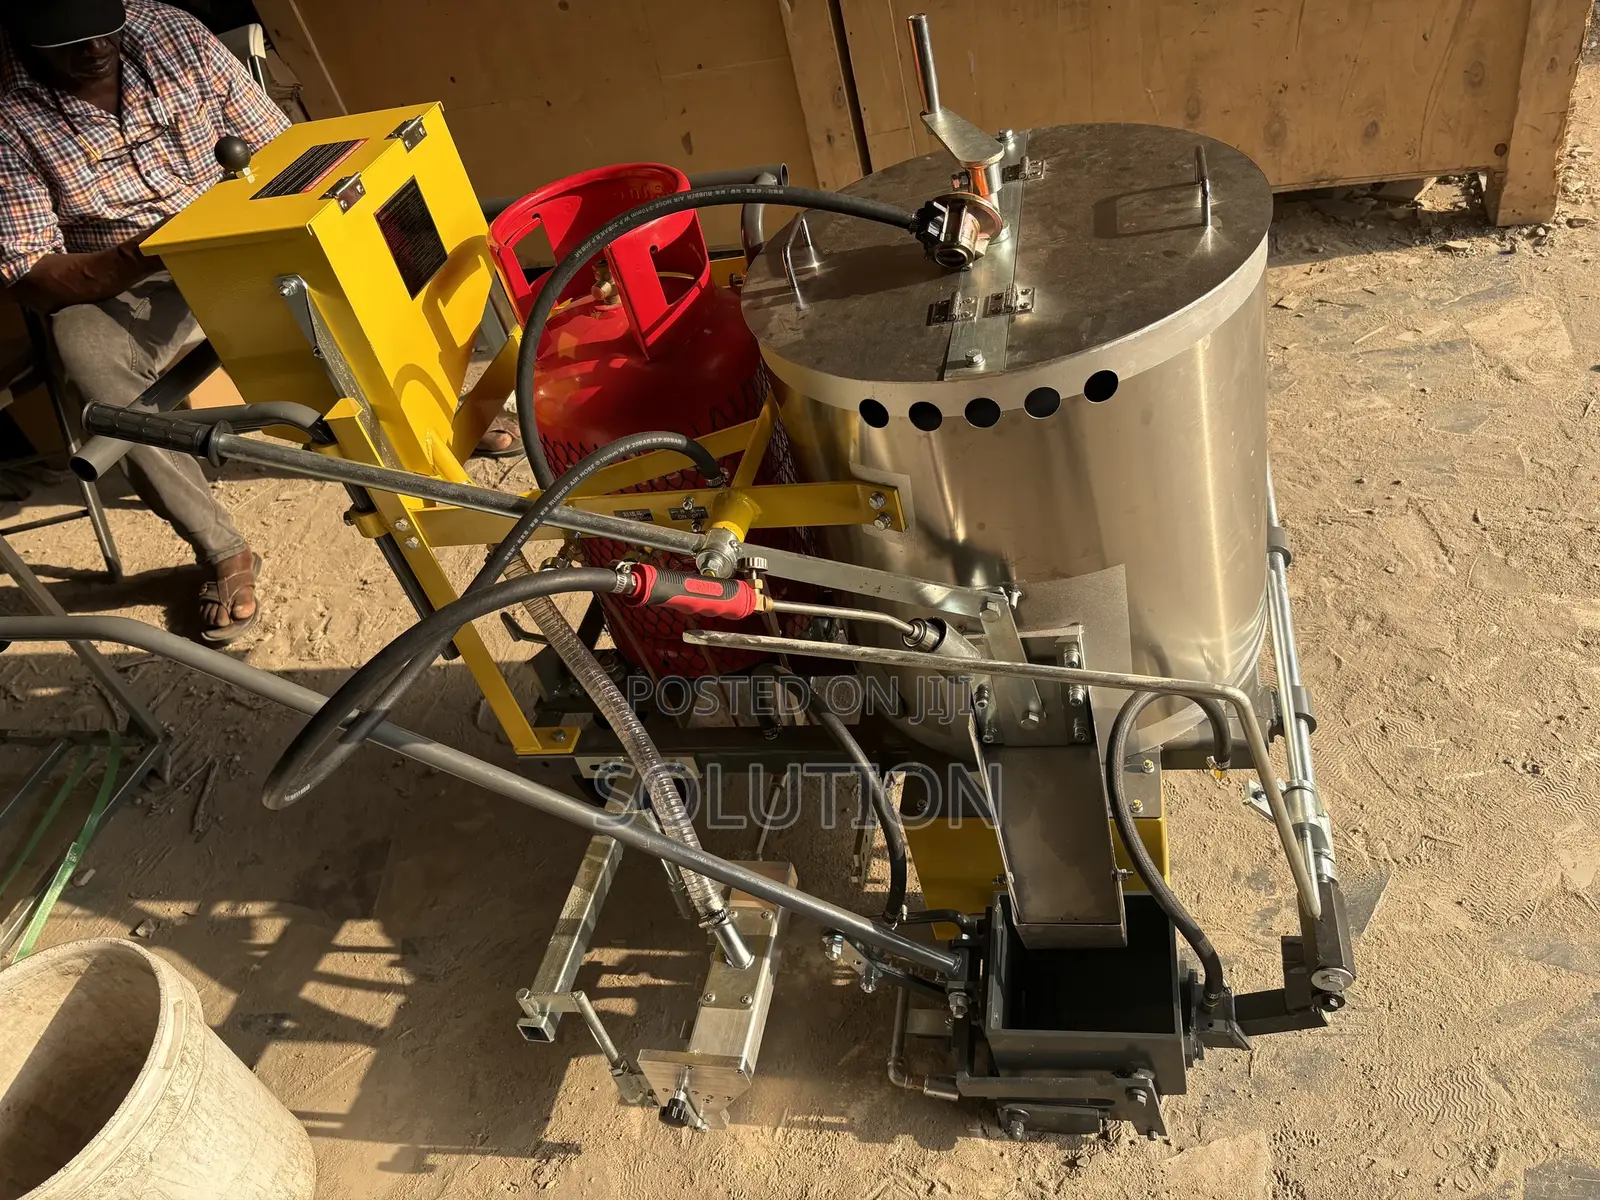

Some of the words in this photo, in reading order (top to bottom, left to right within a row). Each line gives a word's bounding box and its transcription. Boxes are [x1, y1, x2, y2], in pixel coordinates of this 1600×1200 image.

[673, 195, 684, 203] AIR
[687, 189, 712, 200] RUBBER
[655, 199, 672, 209] HOSE
[548, 485, 570, 507] RUBBER
[569, 476, 580, 487] AIR
[579, 463, 596, 478] HOSE
